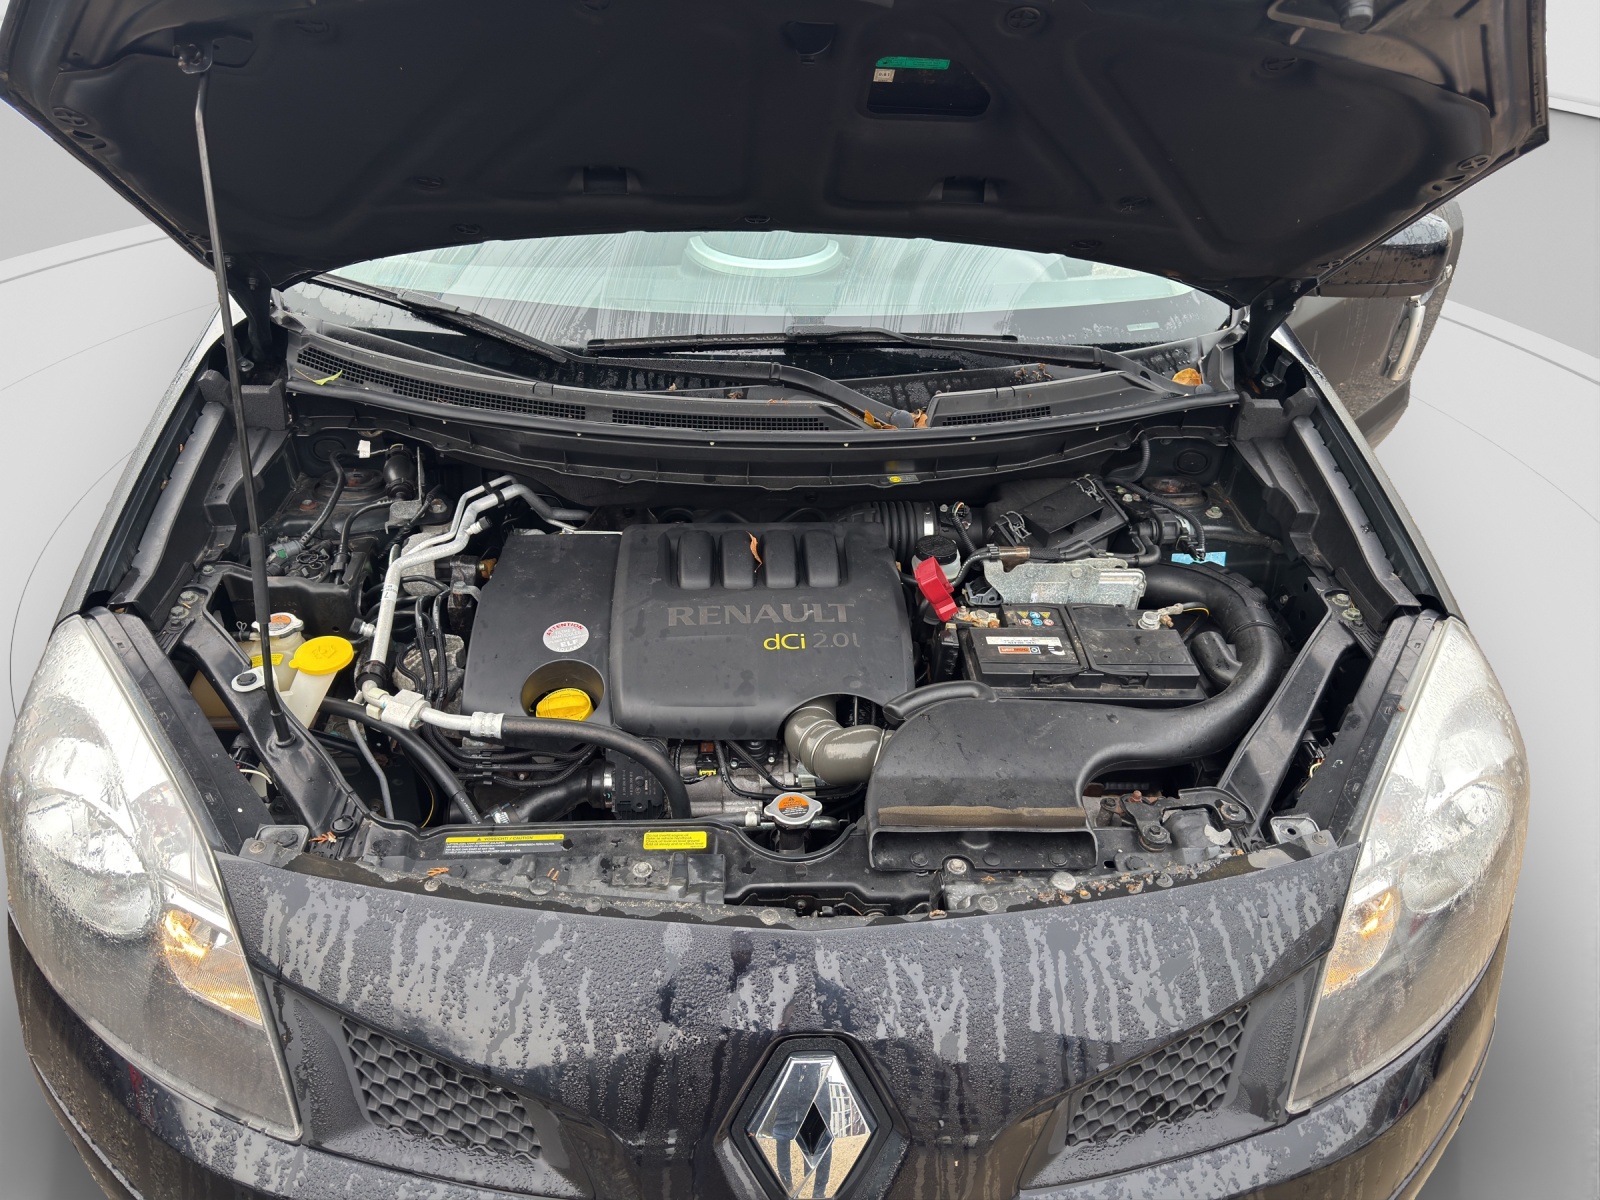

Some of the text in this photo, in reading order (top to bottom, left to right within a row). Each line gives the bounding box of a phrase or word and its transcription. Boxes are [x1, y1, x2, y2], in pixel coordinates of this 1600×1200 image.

[667, 603, 855, 627] RENAULT
[546, 623, 583, 636] ATTENTION
[560, 639, 579, 648] ELF
[763, 633, 806, 650] dCi
